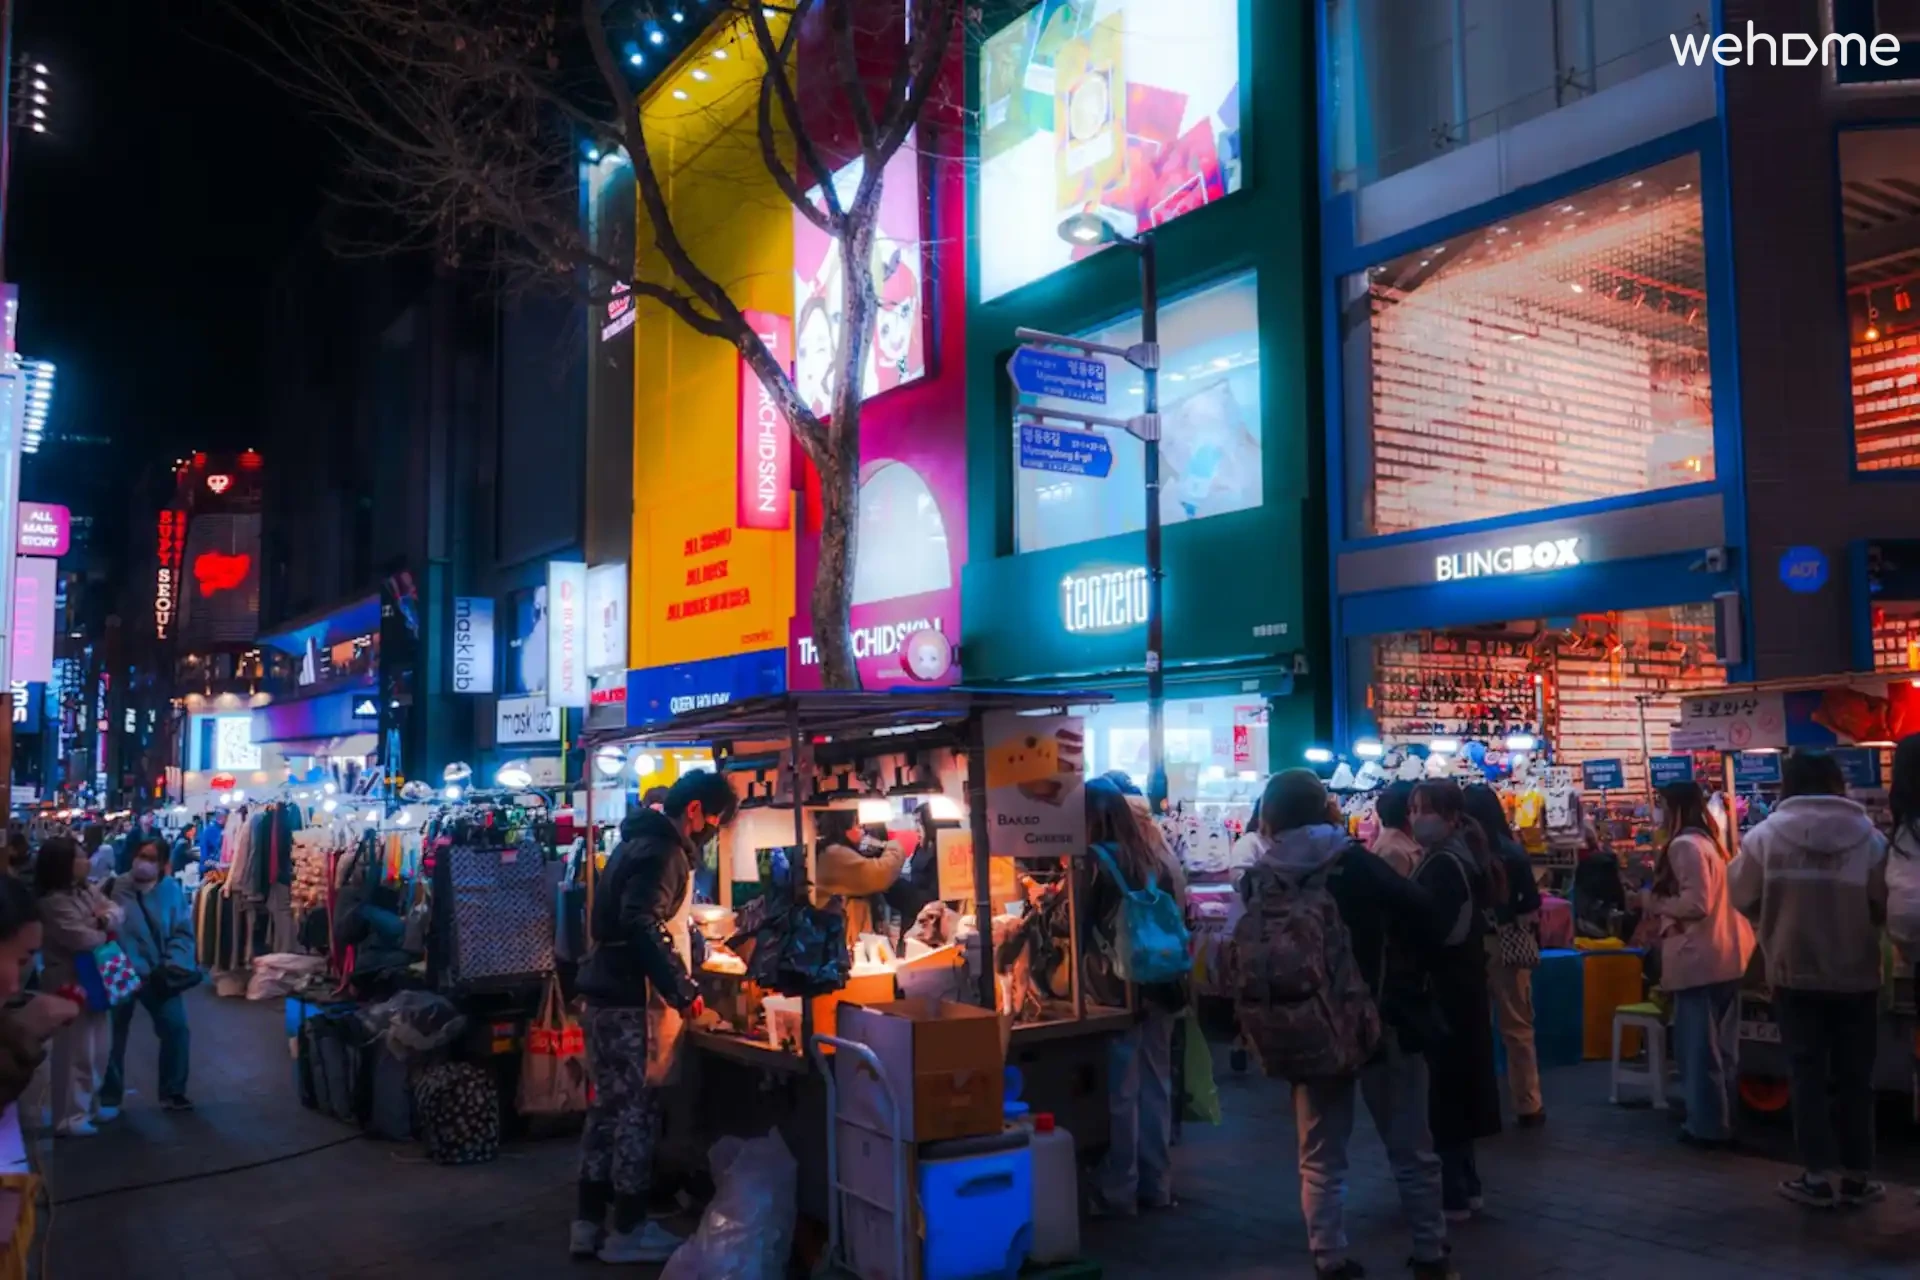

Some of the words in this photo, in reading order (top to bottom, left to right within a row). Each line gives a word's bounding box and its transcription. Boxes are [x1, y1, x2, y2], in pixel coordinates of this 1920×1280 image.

[31, 511, 53, 522] ALL
[1436, 537, 1580, 582] BLINGBOX
[155, 568, 171, 640] SEOUL
[1062, 566, 1148, 632] tenzero
[1689, 699, 1759, 718] 크로와상
[998, 813, 1040, 826] BAKED
[1024, 832, 1074, 844] CHEESE
